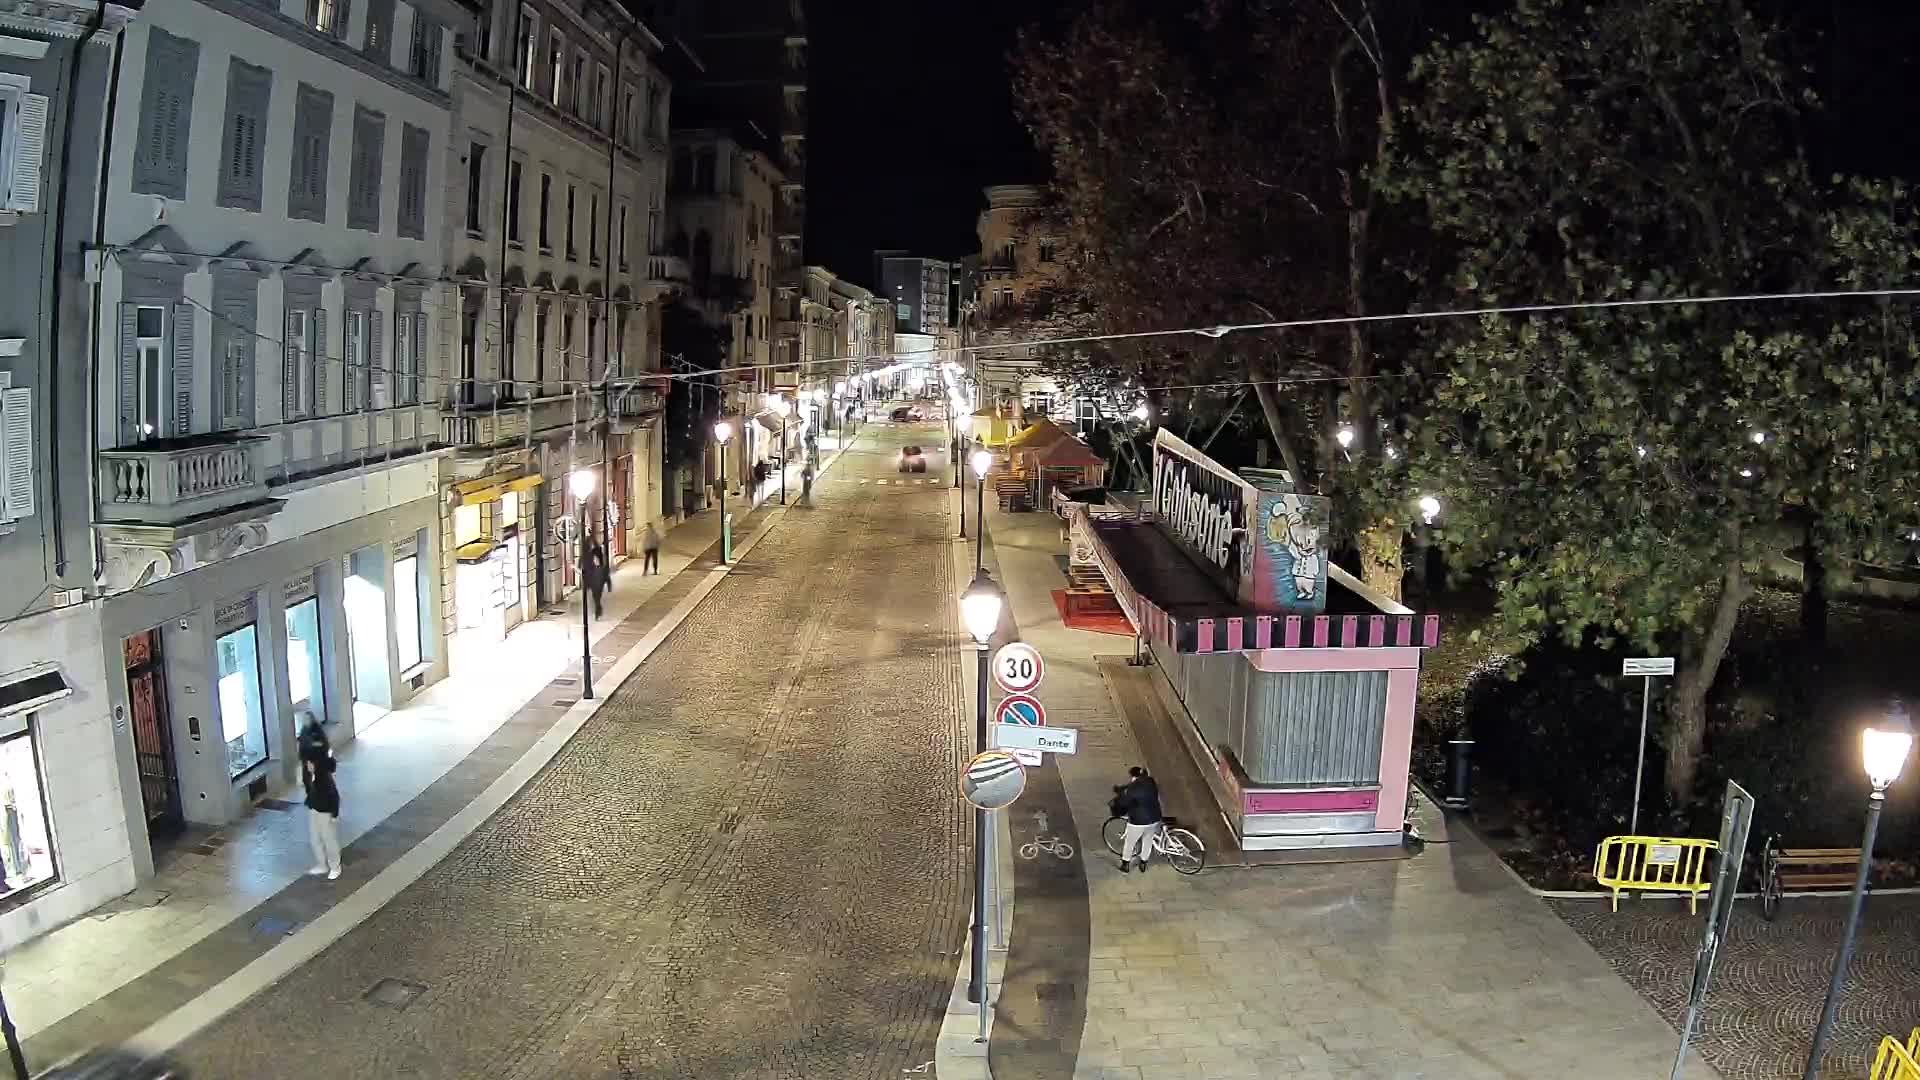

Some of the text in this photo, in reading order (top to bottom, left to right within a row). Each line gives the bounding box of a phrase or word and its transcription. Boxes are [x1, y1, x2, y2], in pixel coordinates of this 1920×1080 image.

[1162, 457, 1233, 569] Golosone
[1006, 657, 1032, 679] 30
[1038, 737, 1069, 748] Dante
